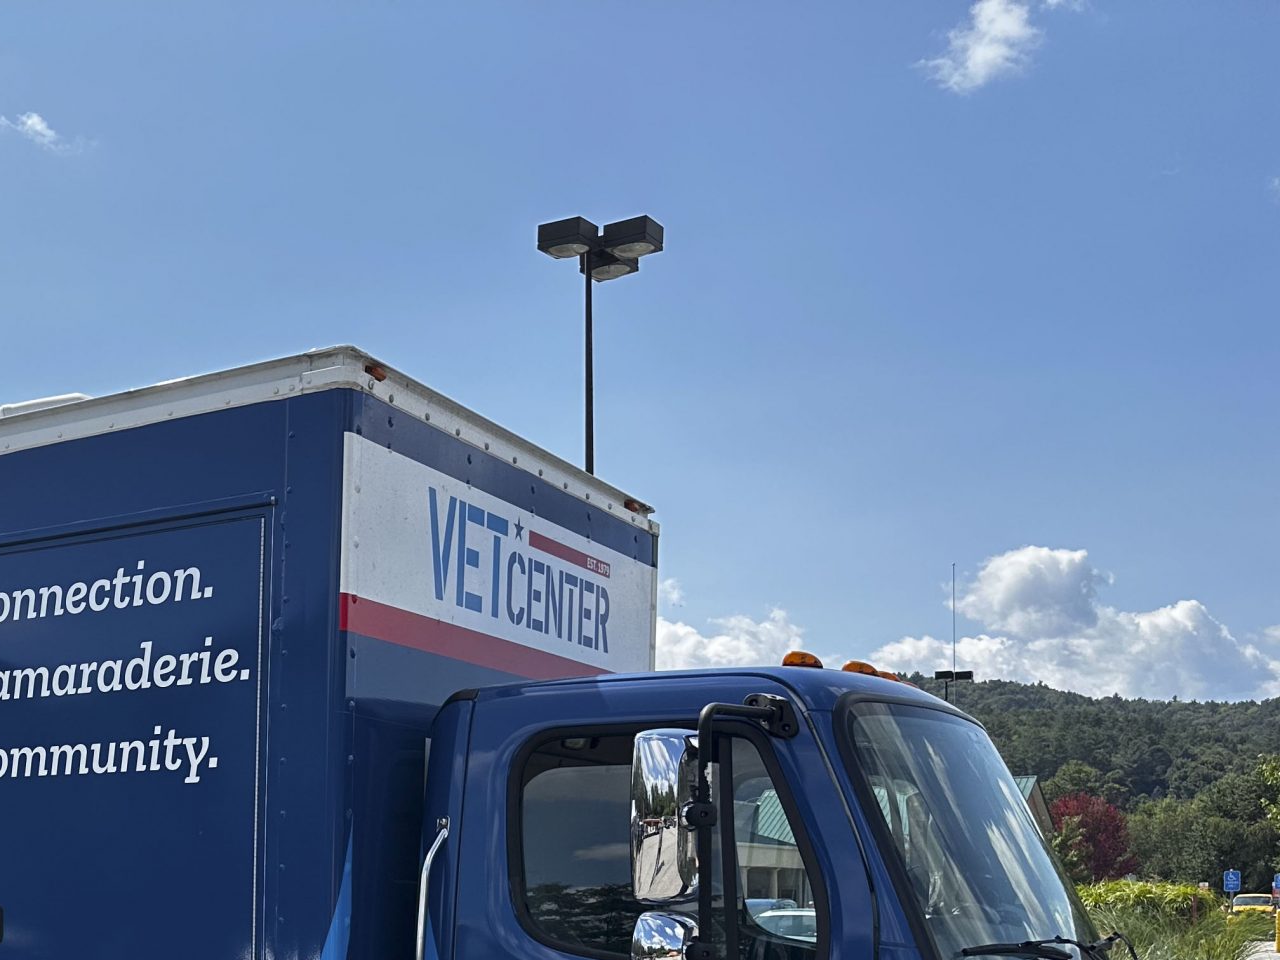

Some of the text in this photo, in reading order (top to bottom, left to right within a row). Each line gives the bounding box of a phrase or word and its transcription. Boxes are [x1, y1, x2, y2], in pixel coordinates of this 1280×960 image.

[428, 486, 610, 653] VET CENTER
[586, 557, 598, 571] EST.
